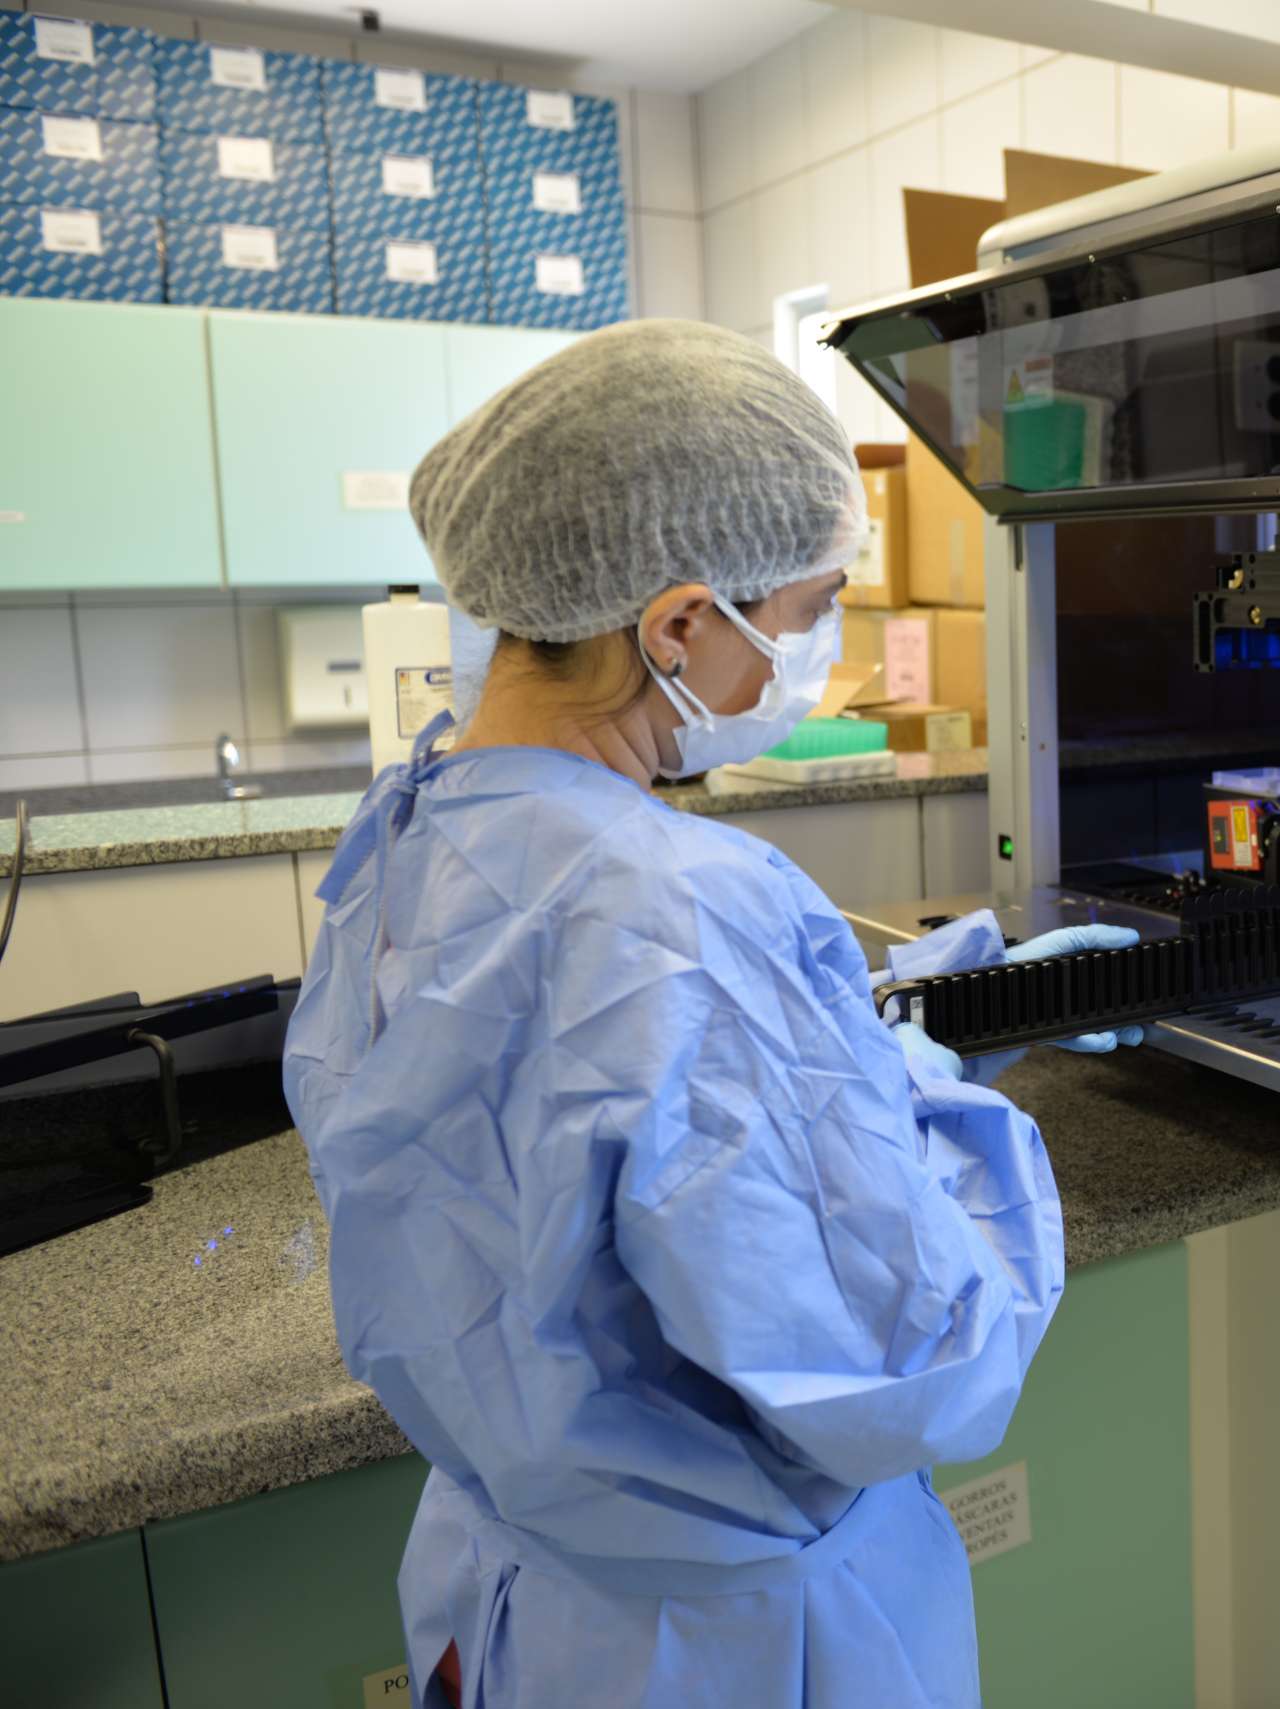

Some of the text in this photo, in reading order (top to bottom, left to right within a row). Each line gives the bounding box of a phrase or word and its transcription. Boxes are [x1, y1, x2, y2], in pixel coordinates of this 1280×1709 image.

[950, 1480, 1007, 1512] GORROS
[955, 1491, 1017, 1525] ÁSCARAS
[959, 1509, 1014, 1538] VENTAIS
[965, 1527, 1009, 1554] ROPÉS
[384, 1674, 409, 1695] PO
